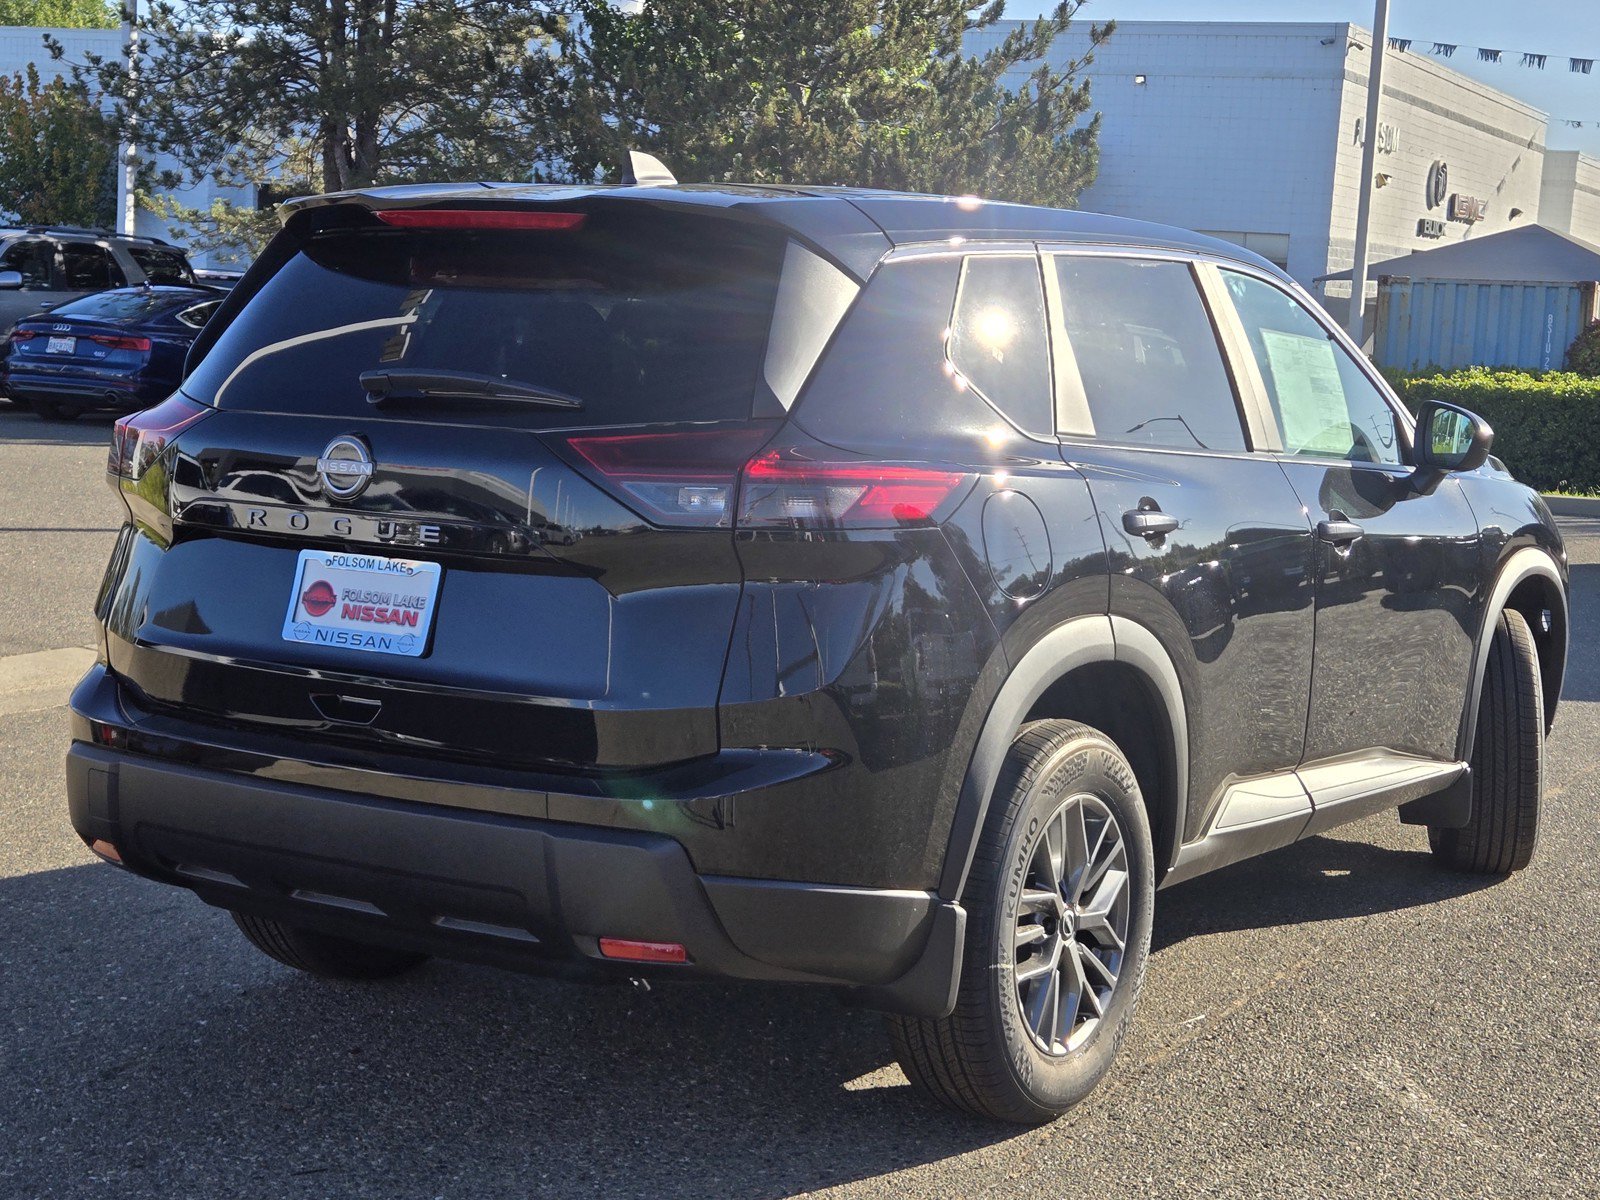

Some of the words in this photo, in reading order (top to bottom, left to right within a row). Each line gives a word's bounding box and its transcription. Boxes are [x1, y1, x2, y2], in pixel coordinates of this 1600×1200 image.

[1423, 219, 1448, 237] BUICK
[318, 461, 372, 474] NISSAN
[248, 508, 442, 543] ROGUE
[331, 555, 375, 569] FOLSOM
[377, 559, 408, 573] LAKE
[341, 588, 391, 605] FOLSOM
[392, 594, 427, 610] LAKE
[340, 603, 419, 627] NISSAN
[314, 629, 392, 650] NISSAN
[1006, 816, 1039, 919] KUMHO
